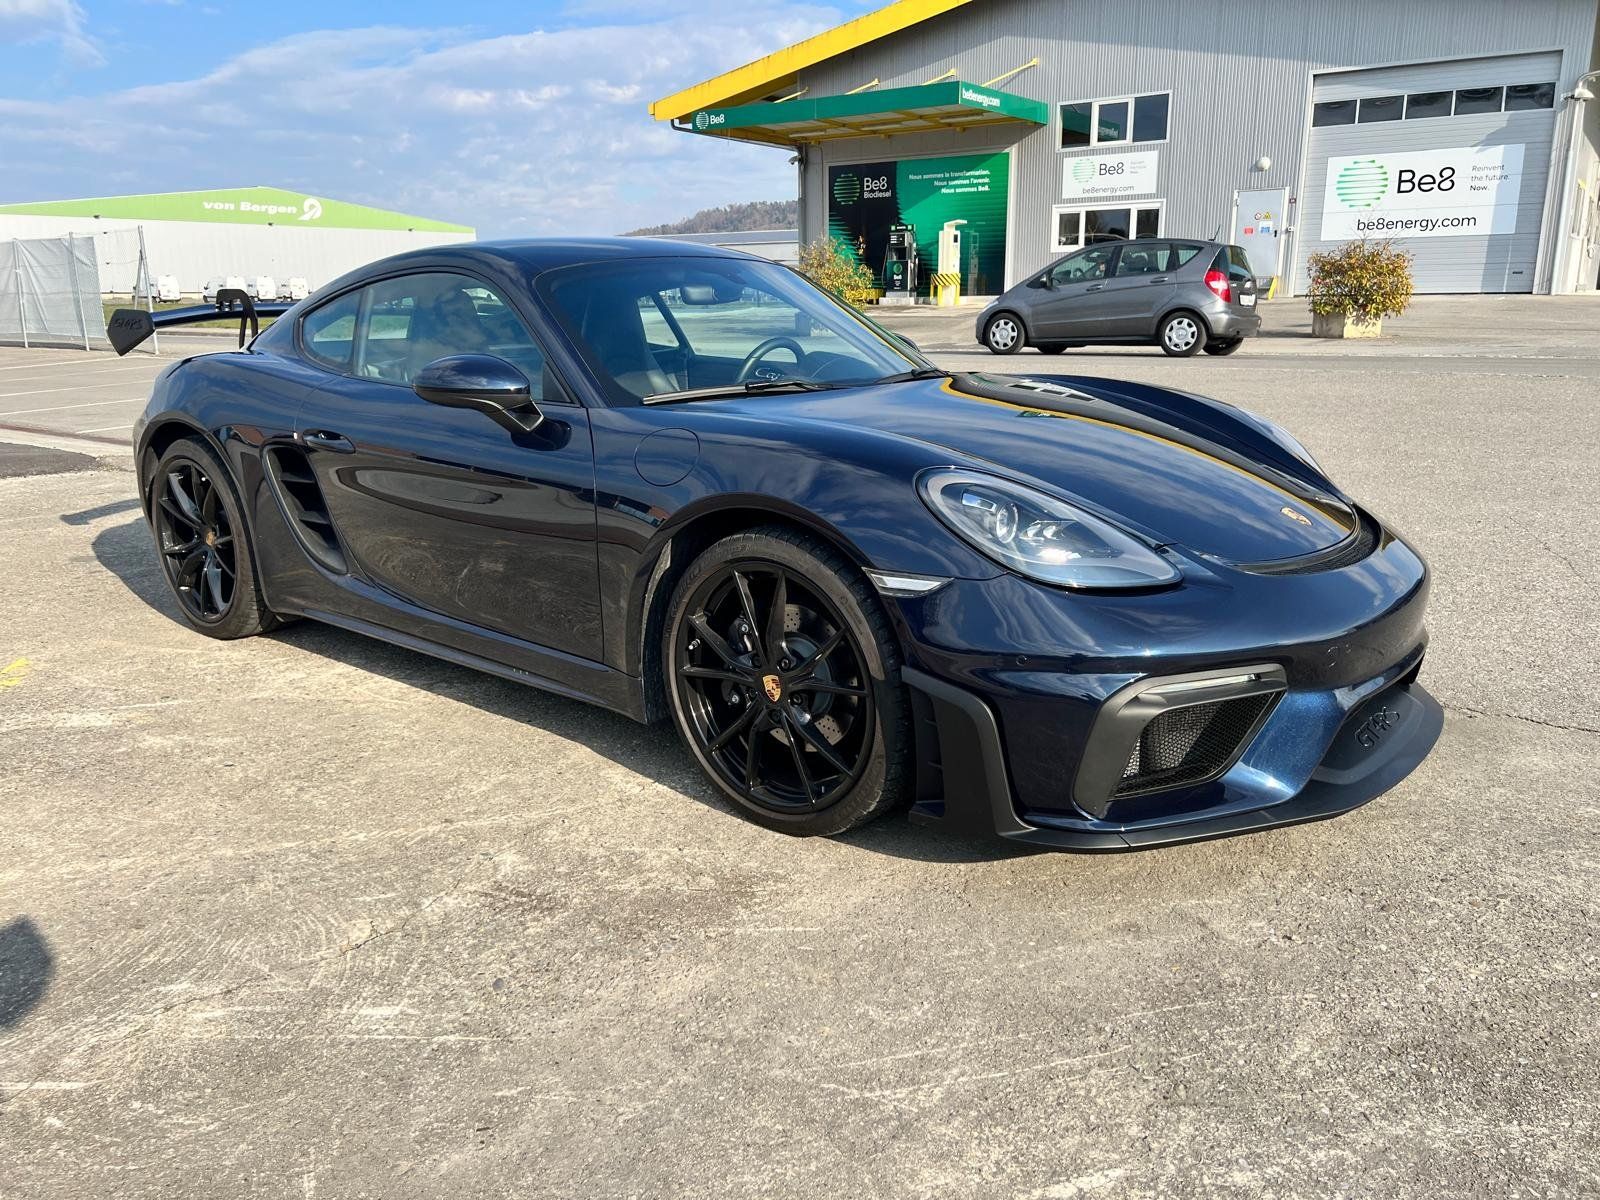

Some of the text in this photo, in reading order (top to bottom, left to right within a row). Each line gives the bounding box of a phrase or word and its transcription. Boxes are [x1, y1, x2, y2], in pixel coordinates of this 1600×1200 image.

[710, 114, 725, 124] Be8
[1099, 162, 1124, 176] Be8
[1472, 164, 1505, 172] Reinvent
[864, 176, 888, 190] Be8
[1397, 166, 1456, 194] Be8
[864, 190, 892, 199] Biodiesel
[1082, 185, 1135, 194] be8energy.com
[203, 202, 297, 215] von Bergen
[1356, 214, 1477, 232] be8energy.com
